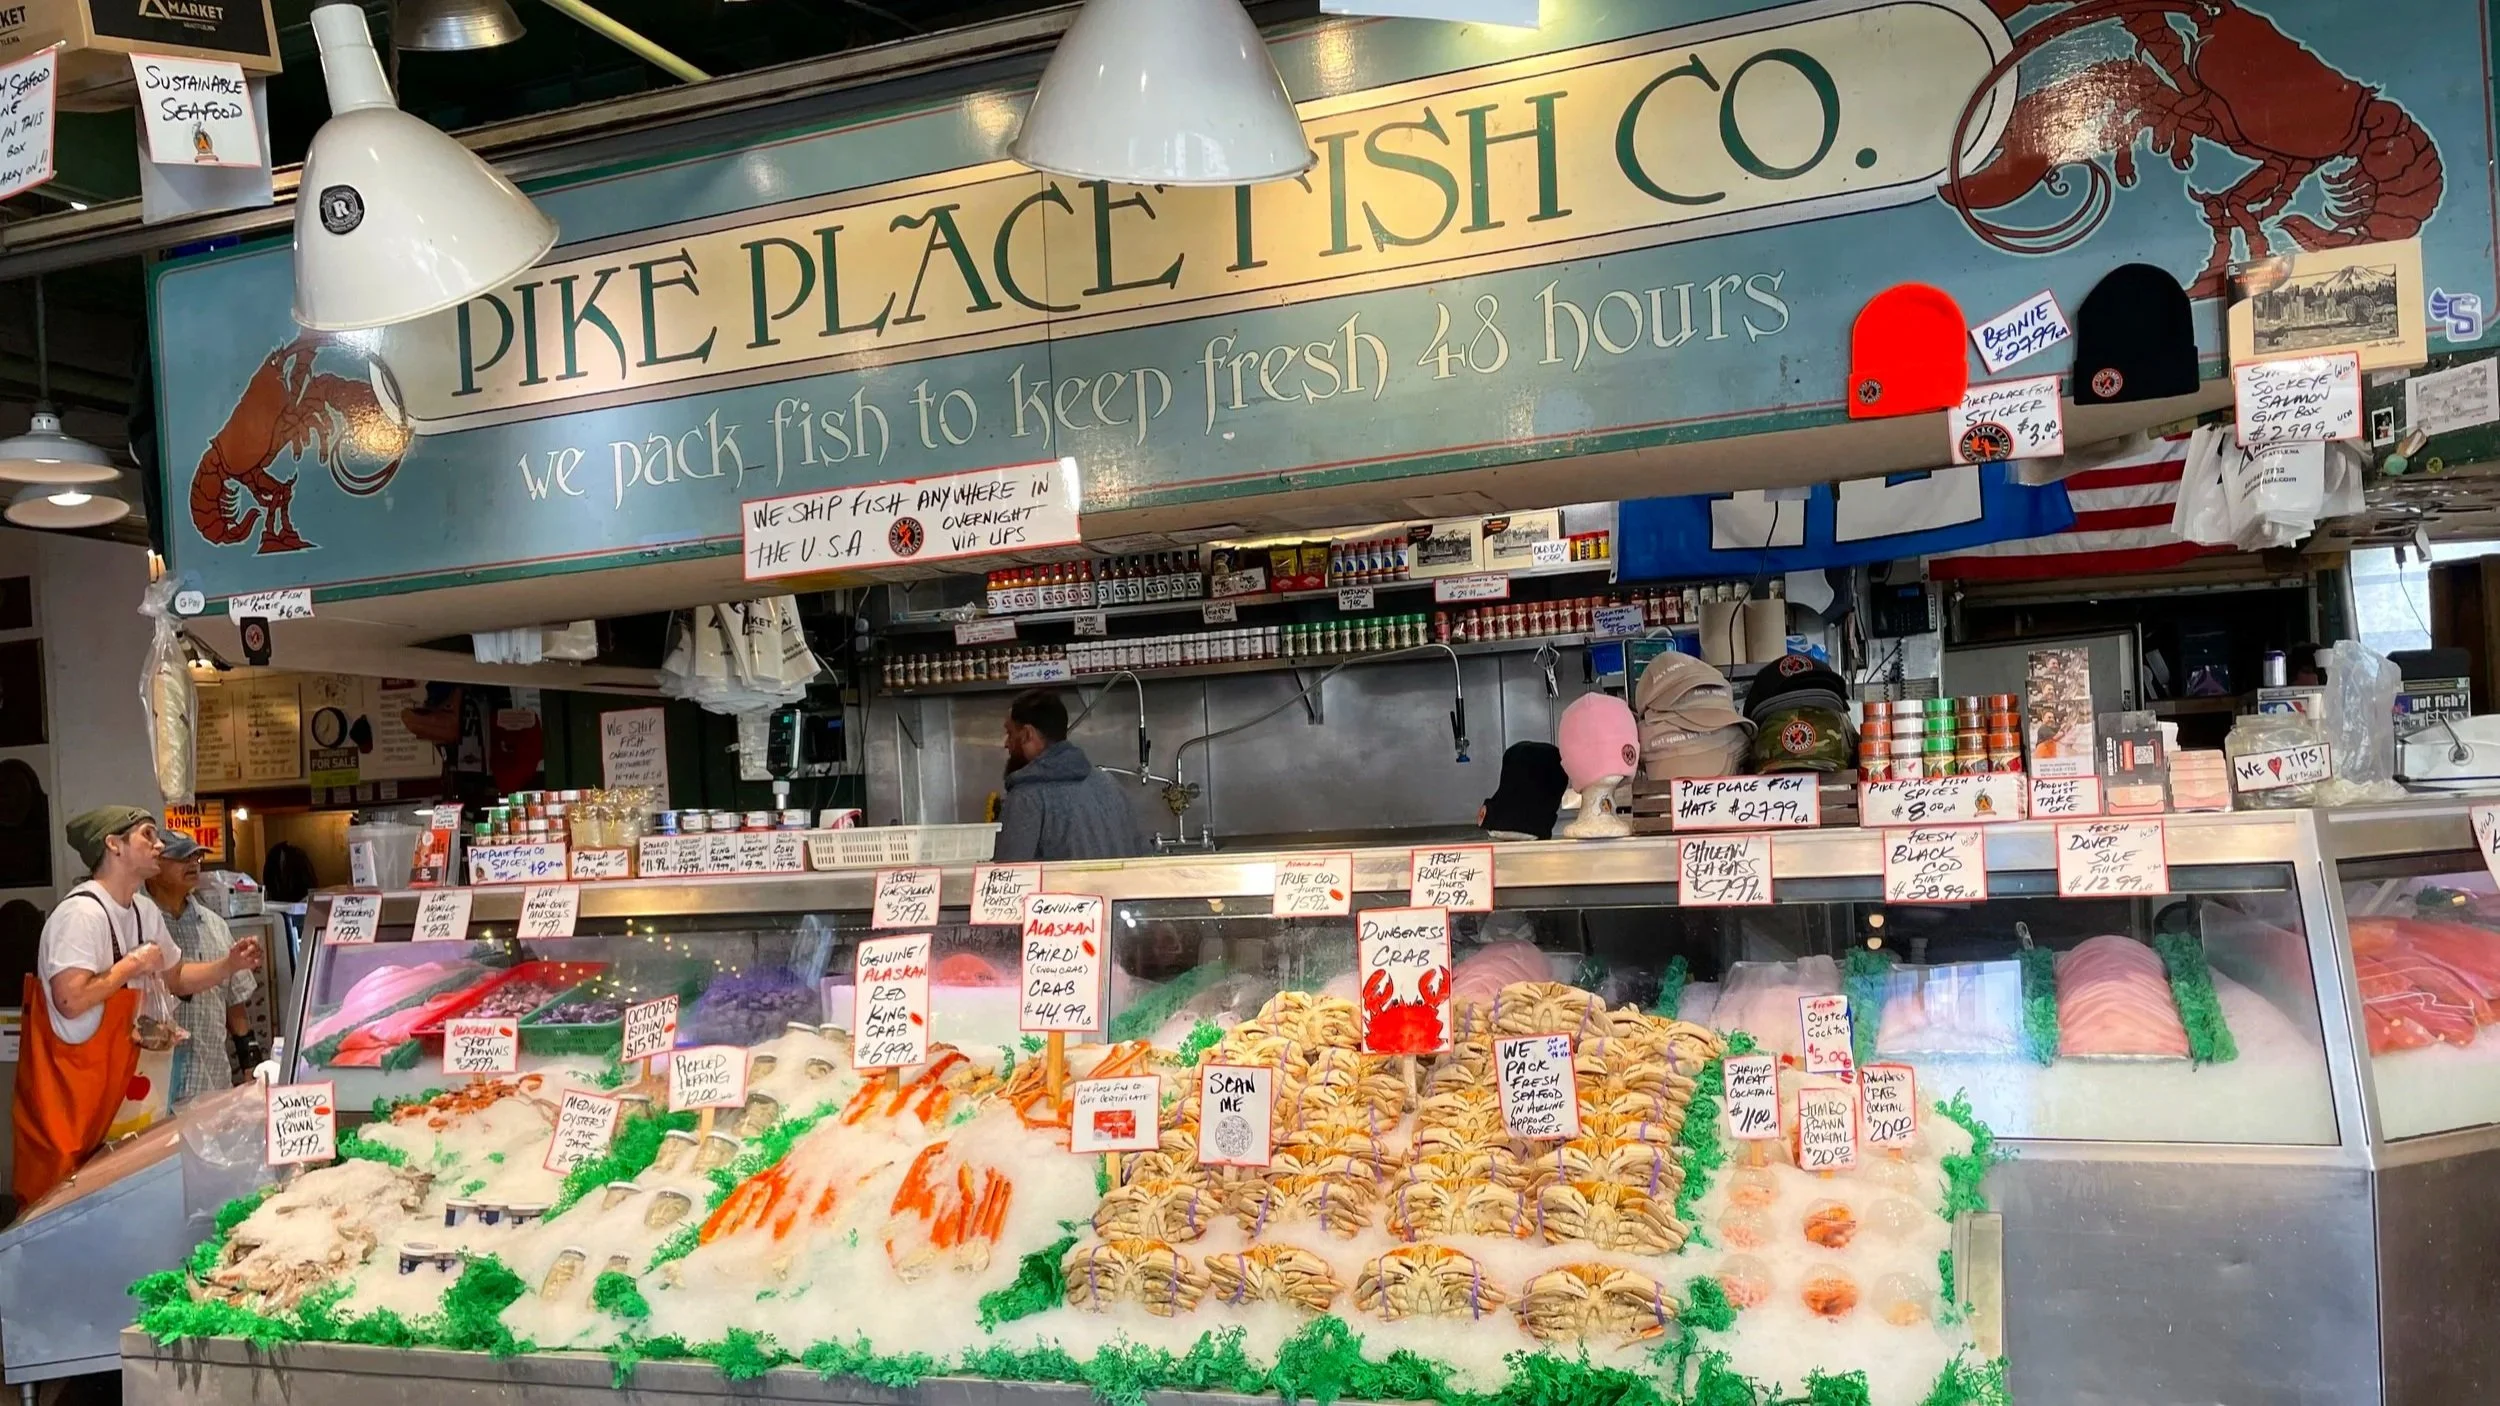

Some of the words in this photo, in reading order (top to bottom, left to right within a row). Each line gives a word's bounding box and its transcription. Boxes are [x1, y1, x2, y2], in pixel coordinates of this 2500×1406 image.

[168, 2, 224, 21] MARKET
[146, 65, 246, 95] SUSTAINABLE
[161, 97, 243, 122] SEAFOOD
[21, 111, 44, 132] THIS
[7, 142, 26, 158] BOX
[452, 248, 718, 396] PIKE
[741, 181, 1184, 349] PLACE
[1615, 48, 1878, 205] CO.
[1983, 299, 2052, 348] BEANIE
[518, 447, 587, 501] we
[608, 408, 746, 510] pack
[768, 386, 889, 488] fish
[909, 378, 978, 450] to
[1009, 362, 1173, 450] keep
[1197, 312, 1389, 436] fresh
[1417, 294, 1510, 381] 48
[1534, 269, 1792, 373] hours
[2252, 373, 2333, 397] SOCKEYE
[1959, 393, 1987, 410] PIKE
[1988, 388, 2025, 406] PLACE
[2257, 386, 2331, 410] SALMON
[1966, 400, 2046, 428] STICKER
[2252, 409, 2293, 422] GIFT
[2295, 405, 2322, 418] BOX
[754, 503, 785, 530] WE
[789, 496, 843, 522] SHIP
[851, 491, 909, 516] FISH
[917, 480, 1016, 511] ANYWHERE
[1031, 472, 1050, 497] IN
[942, 505, 1047, 530] OVERNIGHT
[952, 534, 980, 551] VIA
[989, 527, 1026, 545] UPS
[750, 541, 796, 568] THE
[280, 590, 302, 600] FISH
[2412, 696, 2431, 711] got
[2434, 694, 2466, 707] fish?
[607, 717, 622, 736] WE
[628, 717, 656, 734] SHIP
[620, 736, 646, 748] FISH
[312, 757, 330, 768] FOR
[332, 756, 356, 768] SALE
[2238, 762, 2265, 780] WE
[1682, 781, 1714, 797] PIKE
[1717, 780, 1759, 797] PLACE
[1767, 778, 1803, 792] FISH
[1869, 781, 1895, 794] PIKE
[1900, 779, 1933, 791] PLACE
[1941, 777, 1968, 786] FISH
[1904, 787, 1959, 801] SPICES
[2034, 779, 2080, 792] PRODUCT
[2051, 786, 2079, 795] LIST
[2036, 795, 2082, 807] TAKE
[2048, 803, 2079, 813] ONE
[1678, 800, 1717, 819] HATS
[1728, 799, 1798, 822] $27.99
[1908, 829, 1957, 844] FRESH
[2088, 824, 2130, 832] FRESH
[194, 829, 219, 847] TIP
[2067, 834, 2118, 851] DOVER
[710, 847, 730, 855] KING
[1682, 838, 1749, 862] CHILEAN
[1891, 845, 1955, 864] BLACK
[2087, 849, 2142, 865] SOLE
[492, 858, 526, 870] SPICES
[1718, 858, 1760, 876] BASS
[1922, 858, 1963, 875] COD
[1315, 872, 1340, 884] COD
[1026, 919, 1095, 936] ALASKAN
[1360, 920, 1445, 941] DUNGENESS
[1372, 945, 1430, 967] CRAB
[863, 963, 927, 982] ALASKAN
[870, 986, 906, 1003] RED
[1029, 979, 1075, 996] CRAB
[628, 996, 678, 1025] OCTOPUS
[866, 1004, 907, 1025] KING
[866, 1023, 906, 1038] CRAB
[455, 1037, 502, 1049] SPOT
[1504, 1040, 1538, 1060] WE
[1506, 1060, 1550, 1082] PACK
[1729, 1064, 1772, 1076] SHRIMP
[1210, 1072, 1255, 1094] SCAN
[1510, 1073, 1560, 1089] FRESH
[1733, 1075, 1768, 1085] MEAT
[1512, 1089, 1563, 1103] SEAFOOD
[1730, 1088, 1775, 1099] COCKTAIL
[1864, 1086, 1897, 1101] CRAB
[272, 1094, 327, 1112] JUMBO
[565, 1096, 612, 1117] MEDIUM
[1220, 1097, 1244, 1112] ME
[1511, 1105, 1524, 1118] IN
[1527, 1101, 1565, 1114] AIRLINE
[1800, 1102, 1846, 1119] JUMBO
[562, 1113, 607, 1129] OYSTERS
[1510, 1113, 1555, 1130] APPROVED
[1526, 1124, 1563, 1135] BOXES
[1803, 1131, 1855, 1145] COCKTAIL
